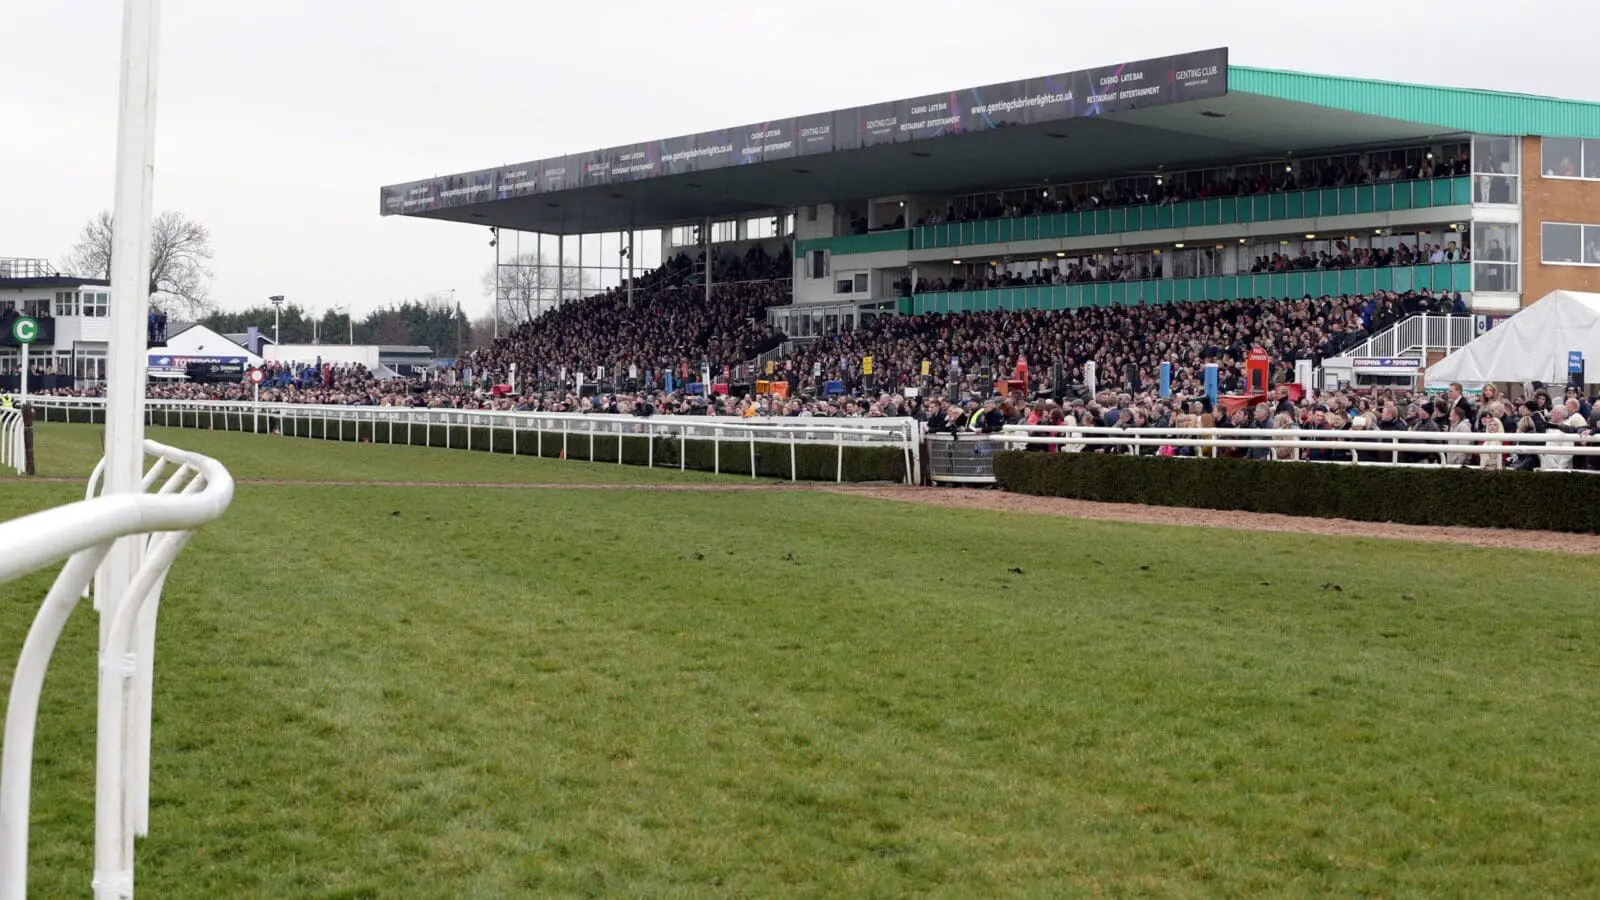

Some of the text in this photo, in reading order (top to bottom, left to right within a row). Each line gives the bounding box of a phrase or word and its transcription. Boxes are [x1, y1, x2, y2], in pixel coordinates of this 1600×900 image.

[1100, 72, 1143, 85] CASINO LATE BAR
[1176, 66, 1217, 80] GENTING CLUB
[971, 90, 1073, 115] www.gentingclubriverlights.co.uk
[1087, 86, 1160, 104] RESTAURANT ENTERTAINMENT
[16, 320, 35, 339] C
